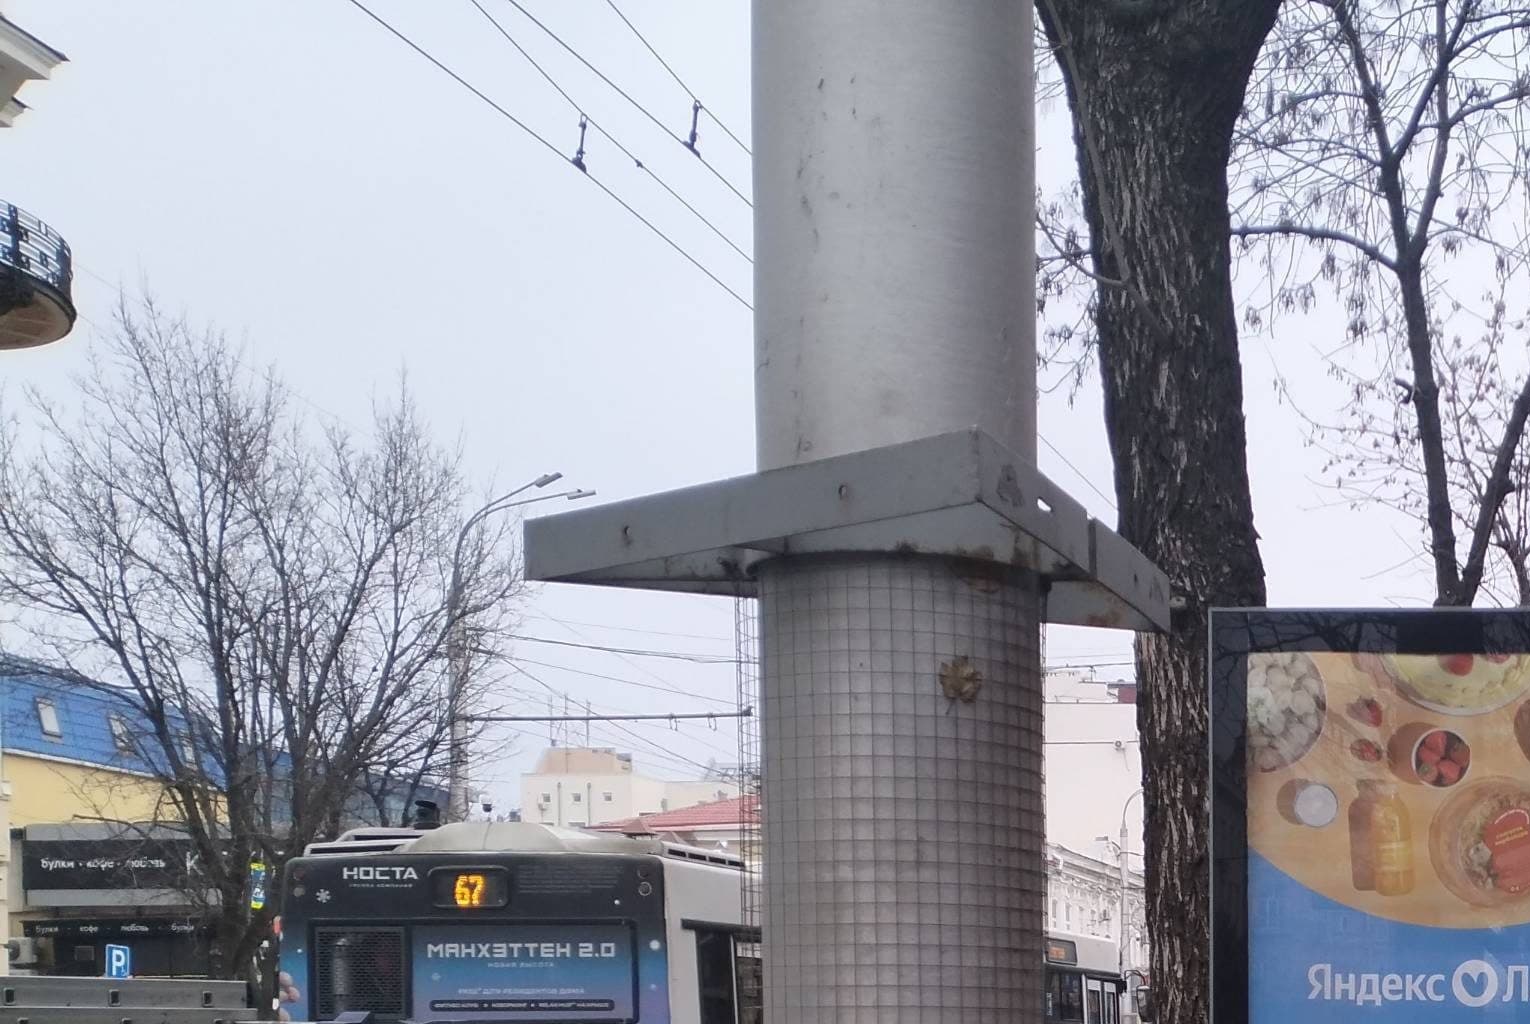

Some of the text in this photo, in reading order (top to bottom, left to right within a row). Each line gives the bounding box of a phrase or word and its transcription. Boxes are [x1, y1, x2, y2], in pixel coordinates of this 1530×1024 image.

[40, 857, 75, 871] булки
[342, 866, 419, 880] НОСТА
[454, 874, 485, 906] 67
[427, 943, 616, 958] МАНХЭТТЕН 2.0
[1307, 963, 1446, 1006] Яндекс
